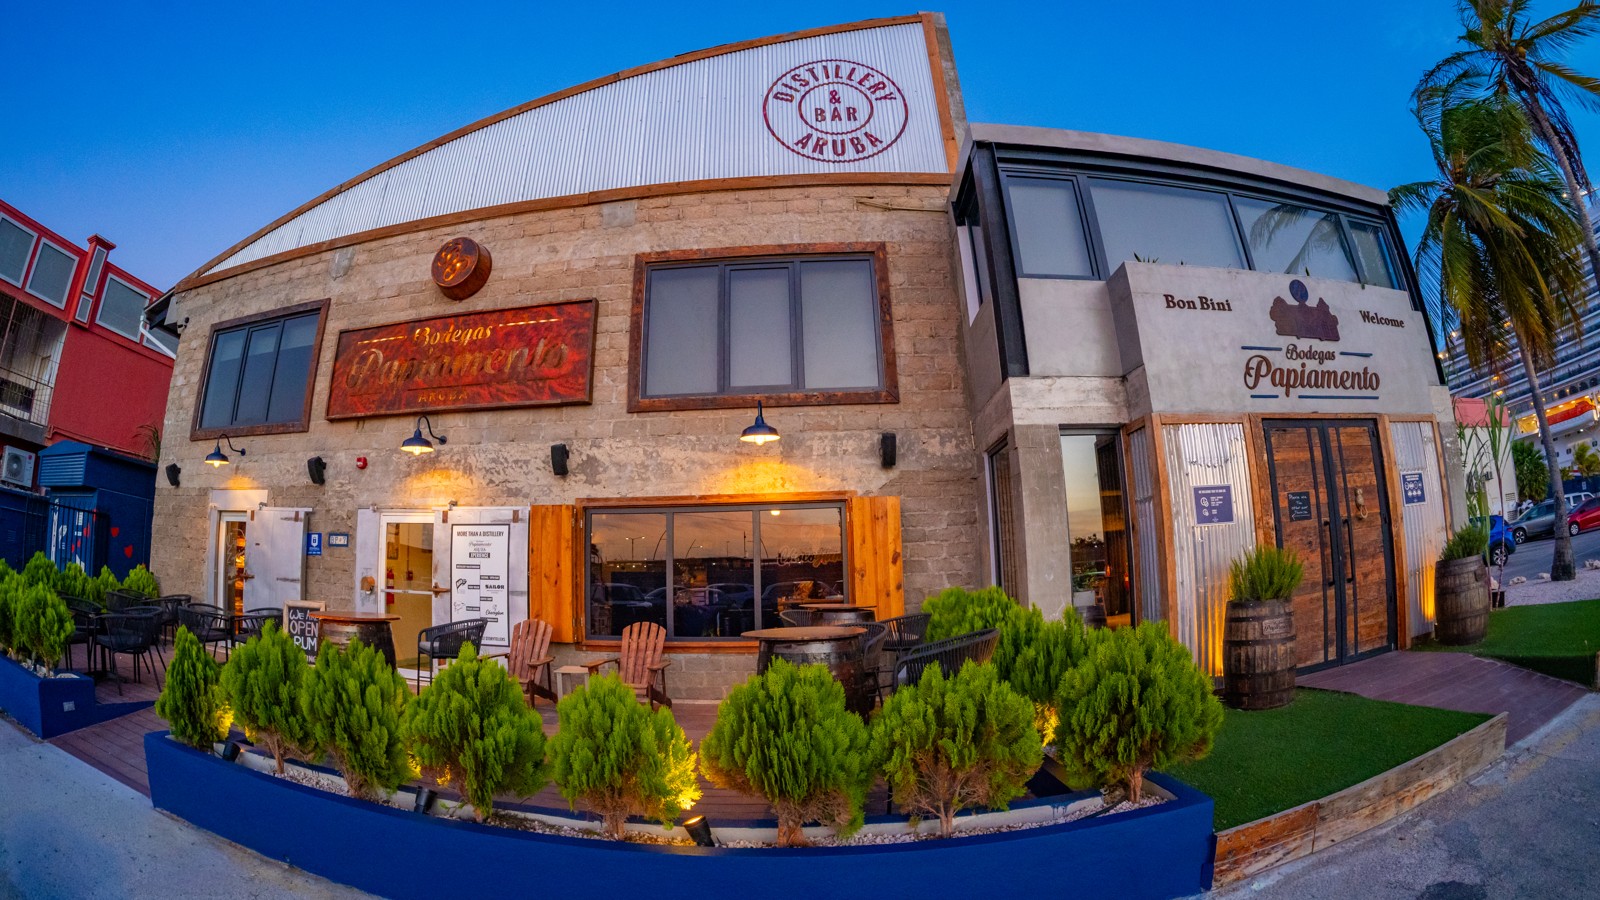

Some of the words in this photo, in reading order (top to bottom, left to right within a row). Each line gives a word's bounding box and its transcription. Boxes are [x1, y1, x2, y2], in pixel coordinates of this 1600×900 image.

[773, 64, 897, 103] DISTILLERY
[829, 89, 841, 104] &
[815, 107, 857, 122] BAR
[794, 132, 883, 157] ARUBA
[1163, 294, 1197, 310] Bon
[1198, 296, 1232, 311] Bini
[1359, 310, 1405, 328] Welcome
[413, 324, 493, 346] Bodegas
[1286, 343, 1336, 365] Bodegas
[345, 337, 568, 394] Papiamento
[1244, 354, 1380, 397] Papiamento
[290, 620, 319, 638] OPEN
[294, 635, 317, 651] RUM
